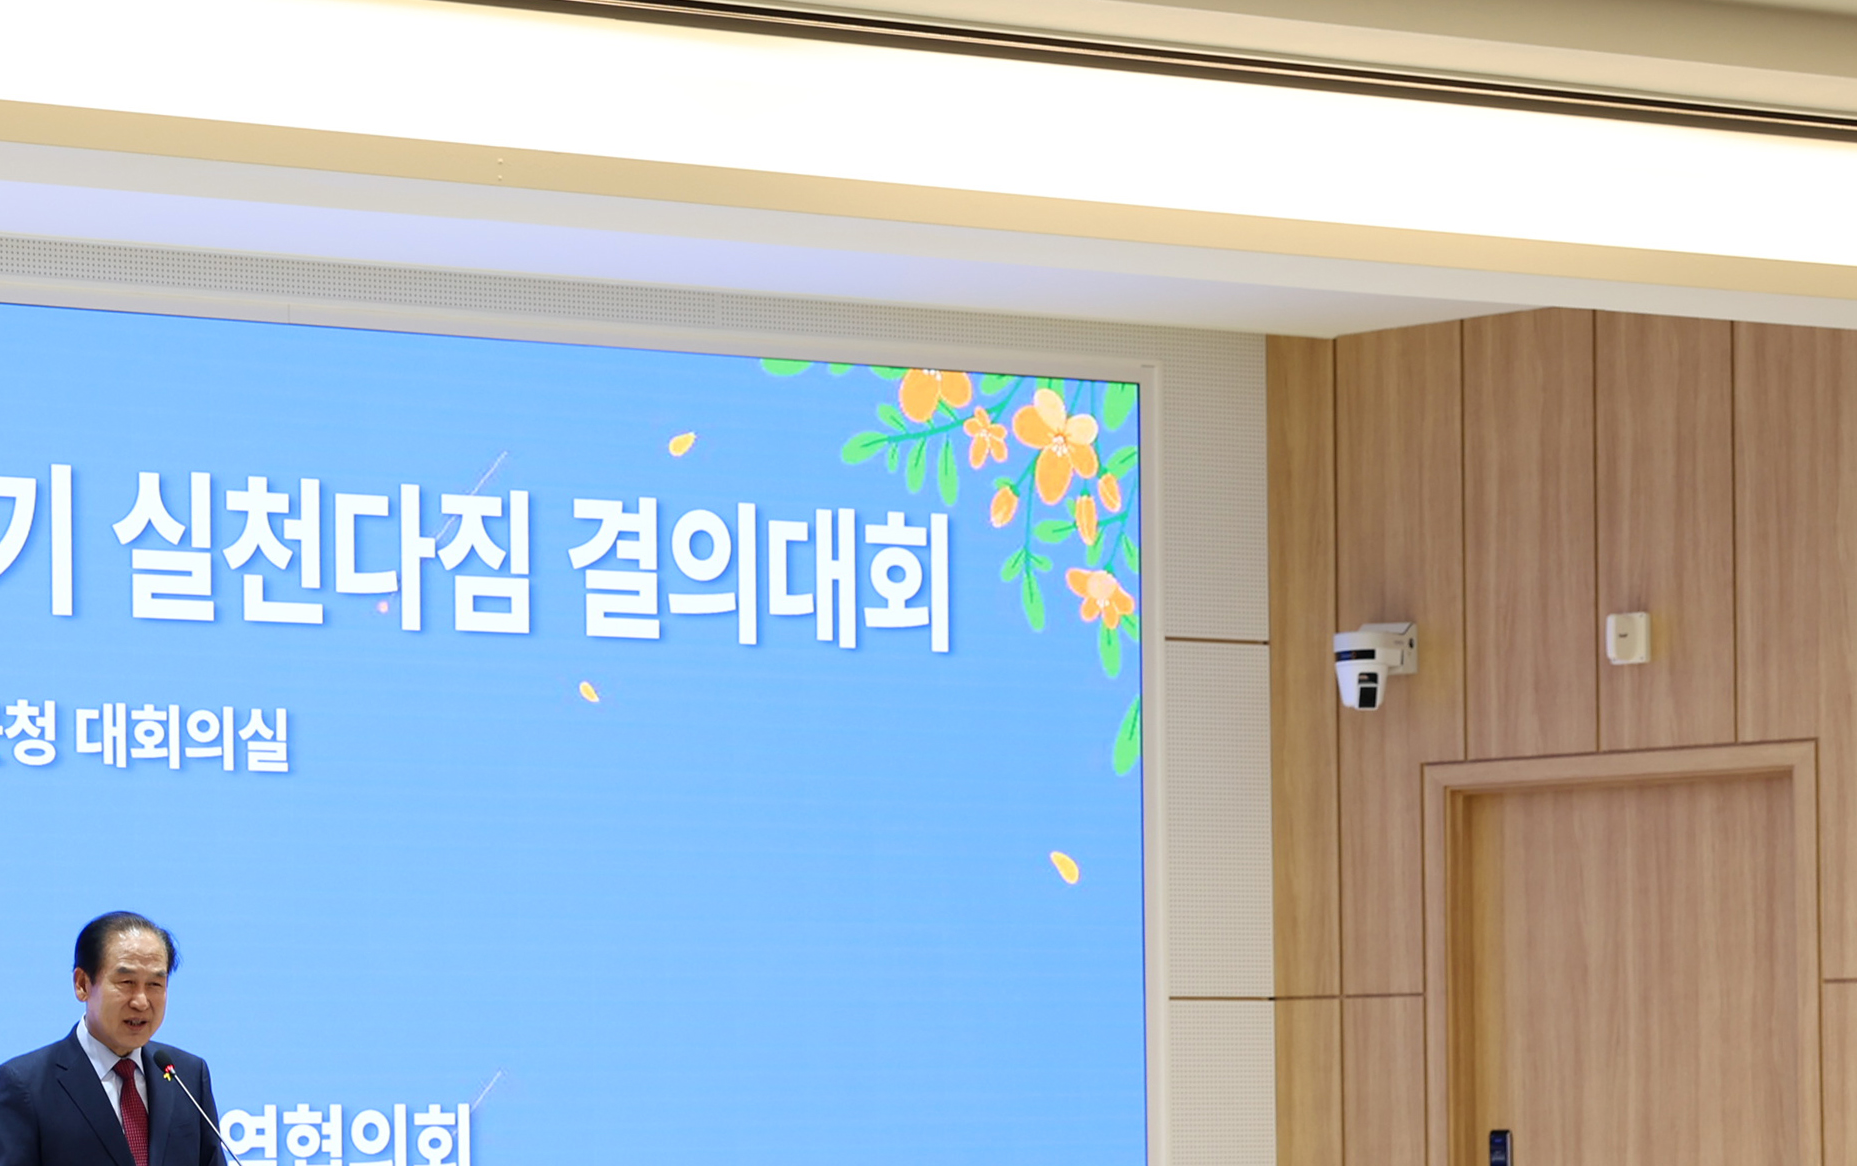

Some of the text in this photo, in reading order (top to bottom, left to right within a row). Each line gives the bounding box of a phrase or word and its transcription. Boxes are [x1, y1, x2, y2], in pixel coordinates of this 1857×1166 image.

[112, 471, 531, 634] 실천다짐
[567, 497, 950, 652] 결의대회
[76, 702, 289, 772] 대회의실
